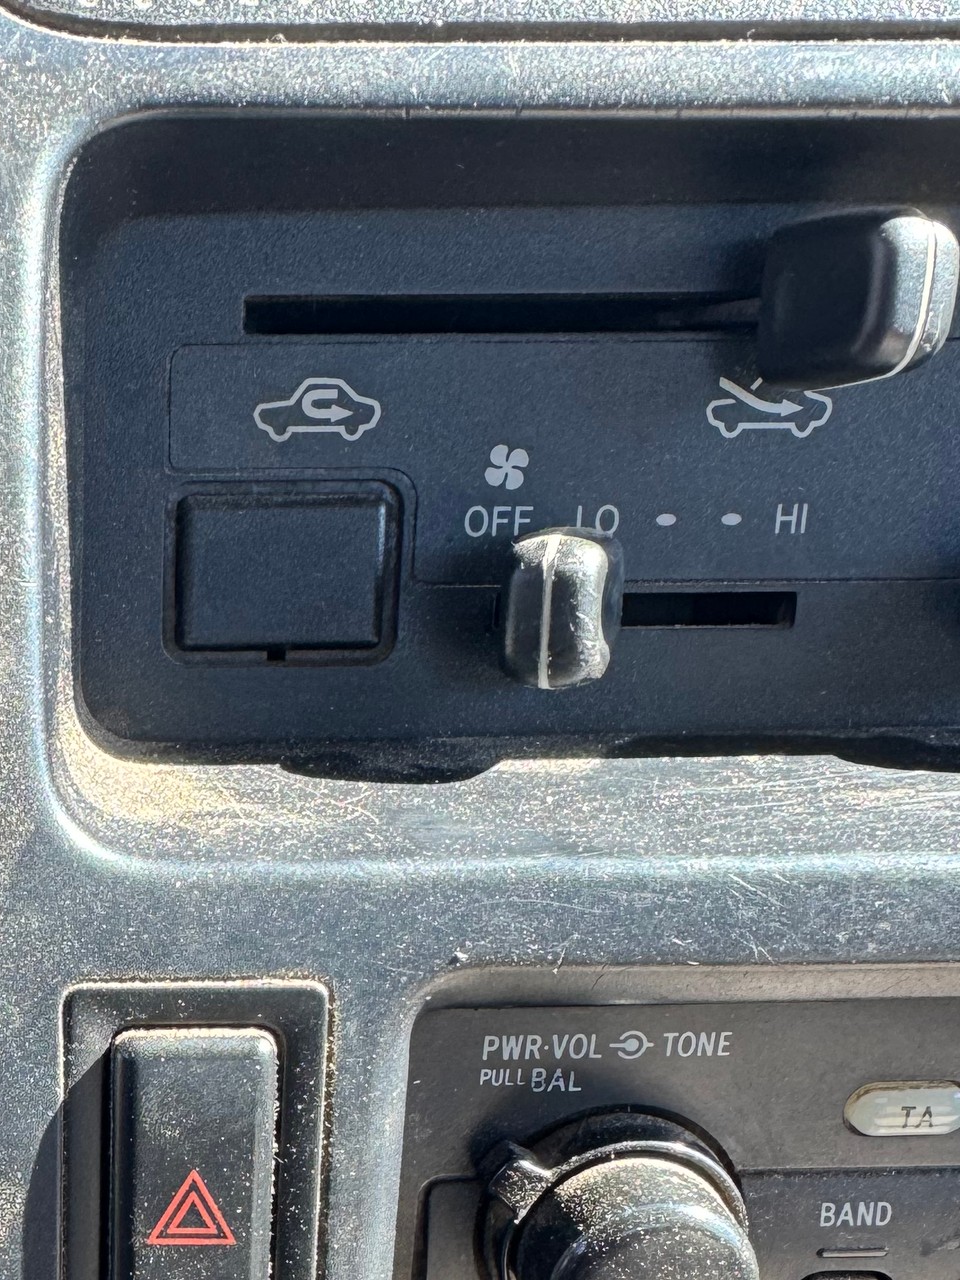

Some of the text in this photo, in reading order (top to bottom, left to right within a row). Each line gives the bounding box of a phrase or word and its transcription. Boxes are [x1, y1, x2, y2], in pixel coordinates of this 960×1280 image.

[464, 505, 534, 538] OFF
[774, 503, 808, 535] HI
[663, 1031, 733, 1058] TONE
[480, 1068, 582, 1092] PULL BAL
[901, 1106, 933, 1129] TA
[819, 1202, 892, 1227] BAND
